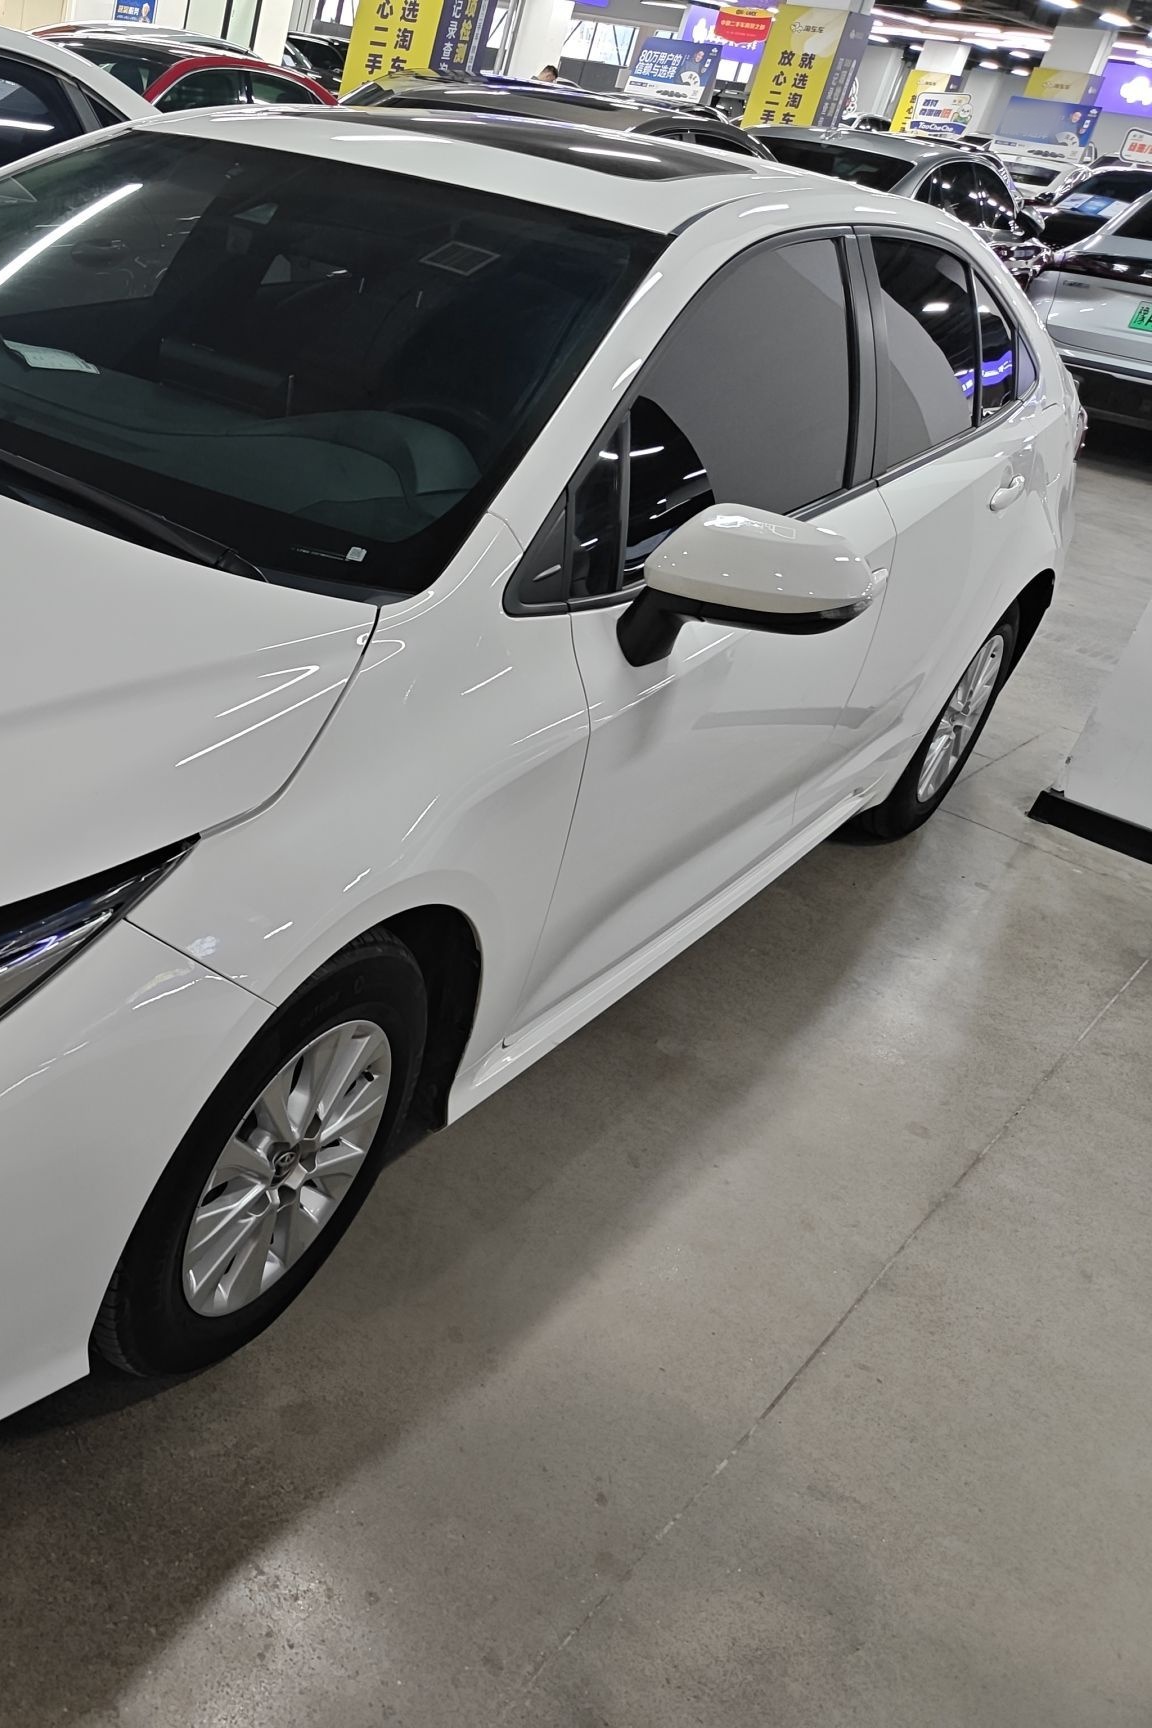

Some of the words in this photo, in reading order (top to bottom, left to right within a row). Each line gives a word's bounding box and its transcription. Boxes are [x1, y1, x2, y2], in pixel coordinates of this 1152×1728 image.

[362, 0, 394, 84] 心二手
[634, 62, 678, 79] 信赖与选择
[639, 49, 683, 67] 80万用户的
[760, 50, 795, 125] 放心二手
[780, 52, 816, 125] 就选淘车
